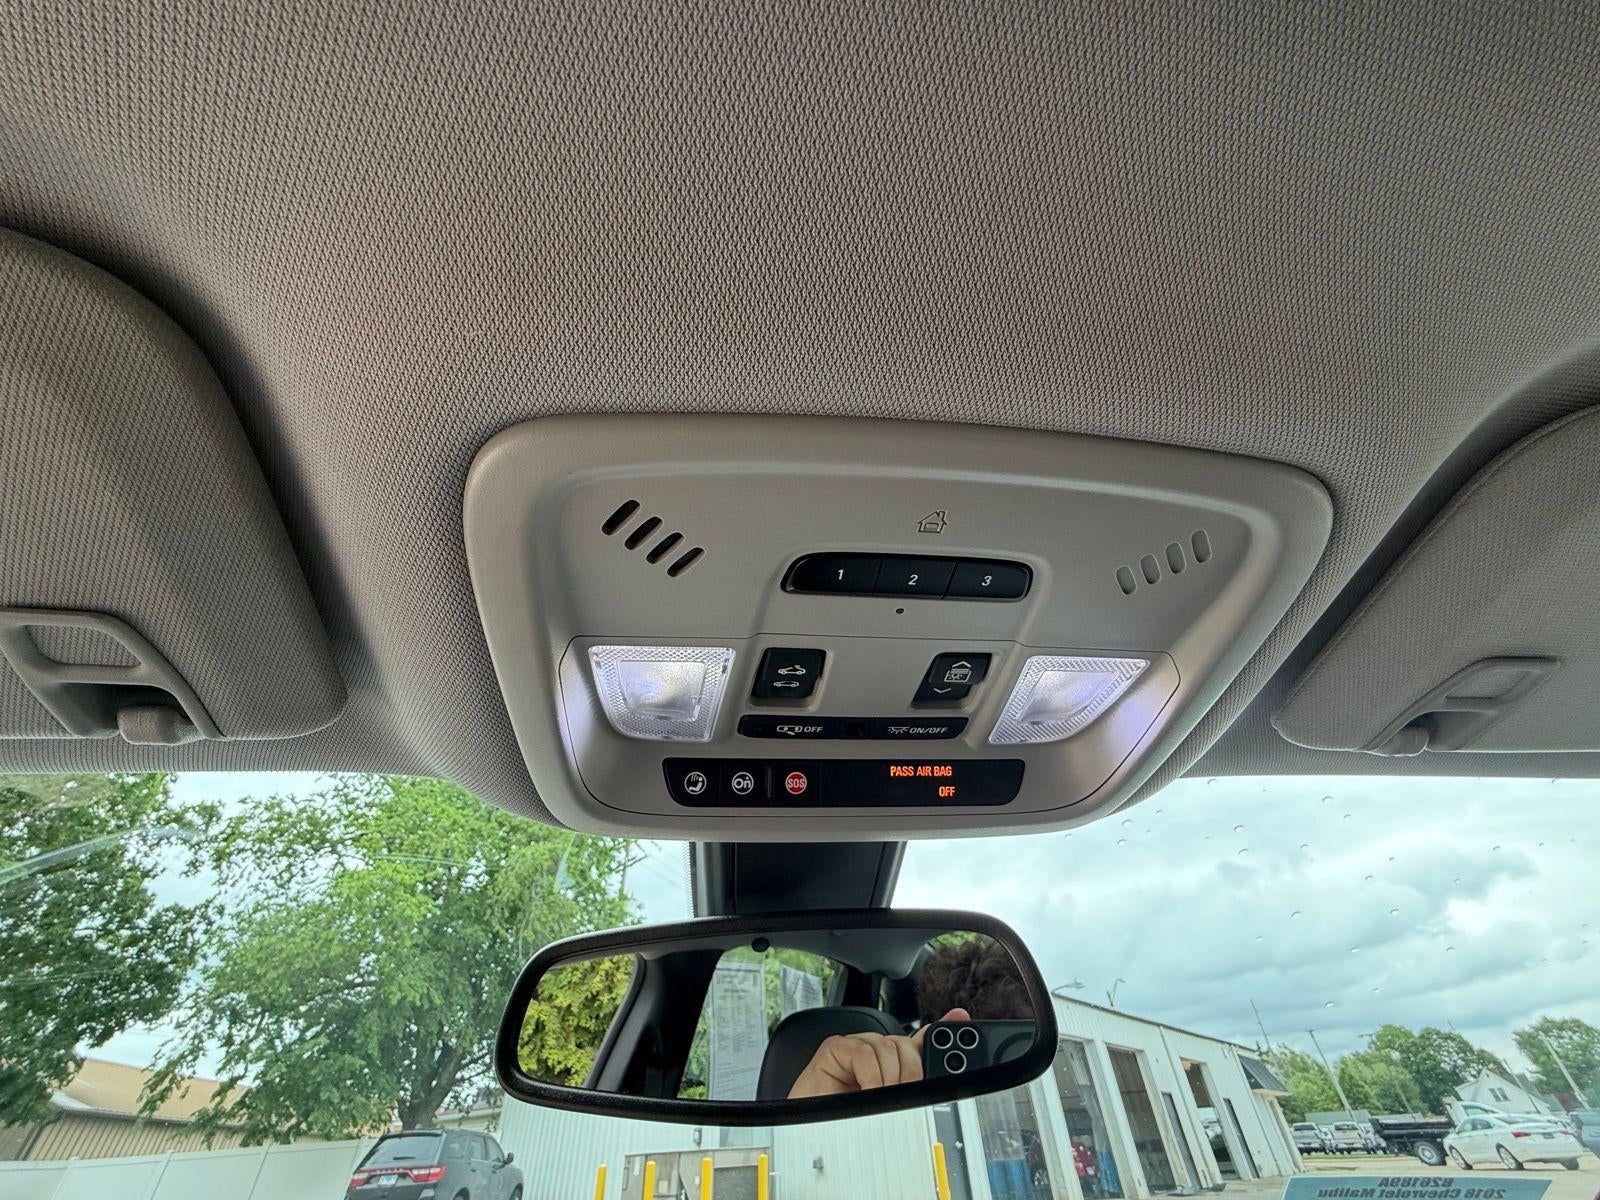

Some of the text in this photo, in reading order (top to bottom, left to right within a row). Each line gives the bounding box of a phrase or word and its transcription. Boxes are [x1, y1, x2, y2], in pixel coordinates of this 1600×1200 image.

[837, 569, 844, 581] 1
[907, 574, 919, 586] 2
[981, 575, 993, 587] 3
[909, 726, 948, 734] ON/OFF
[890, 765, 952, 777] PASS AIR BAG
[787, 778, 805, 789] SOS
[938, 786, 956, 797] OFF
